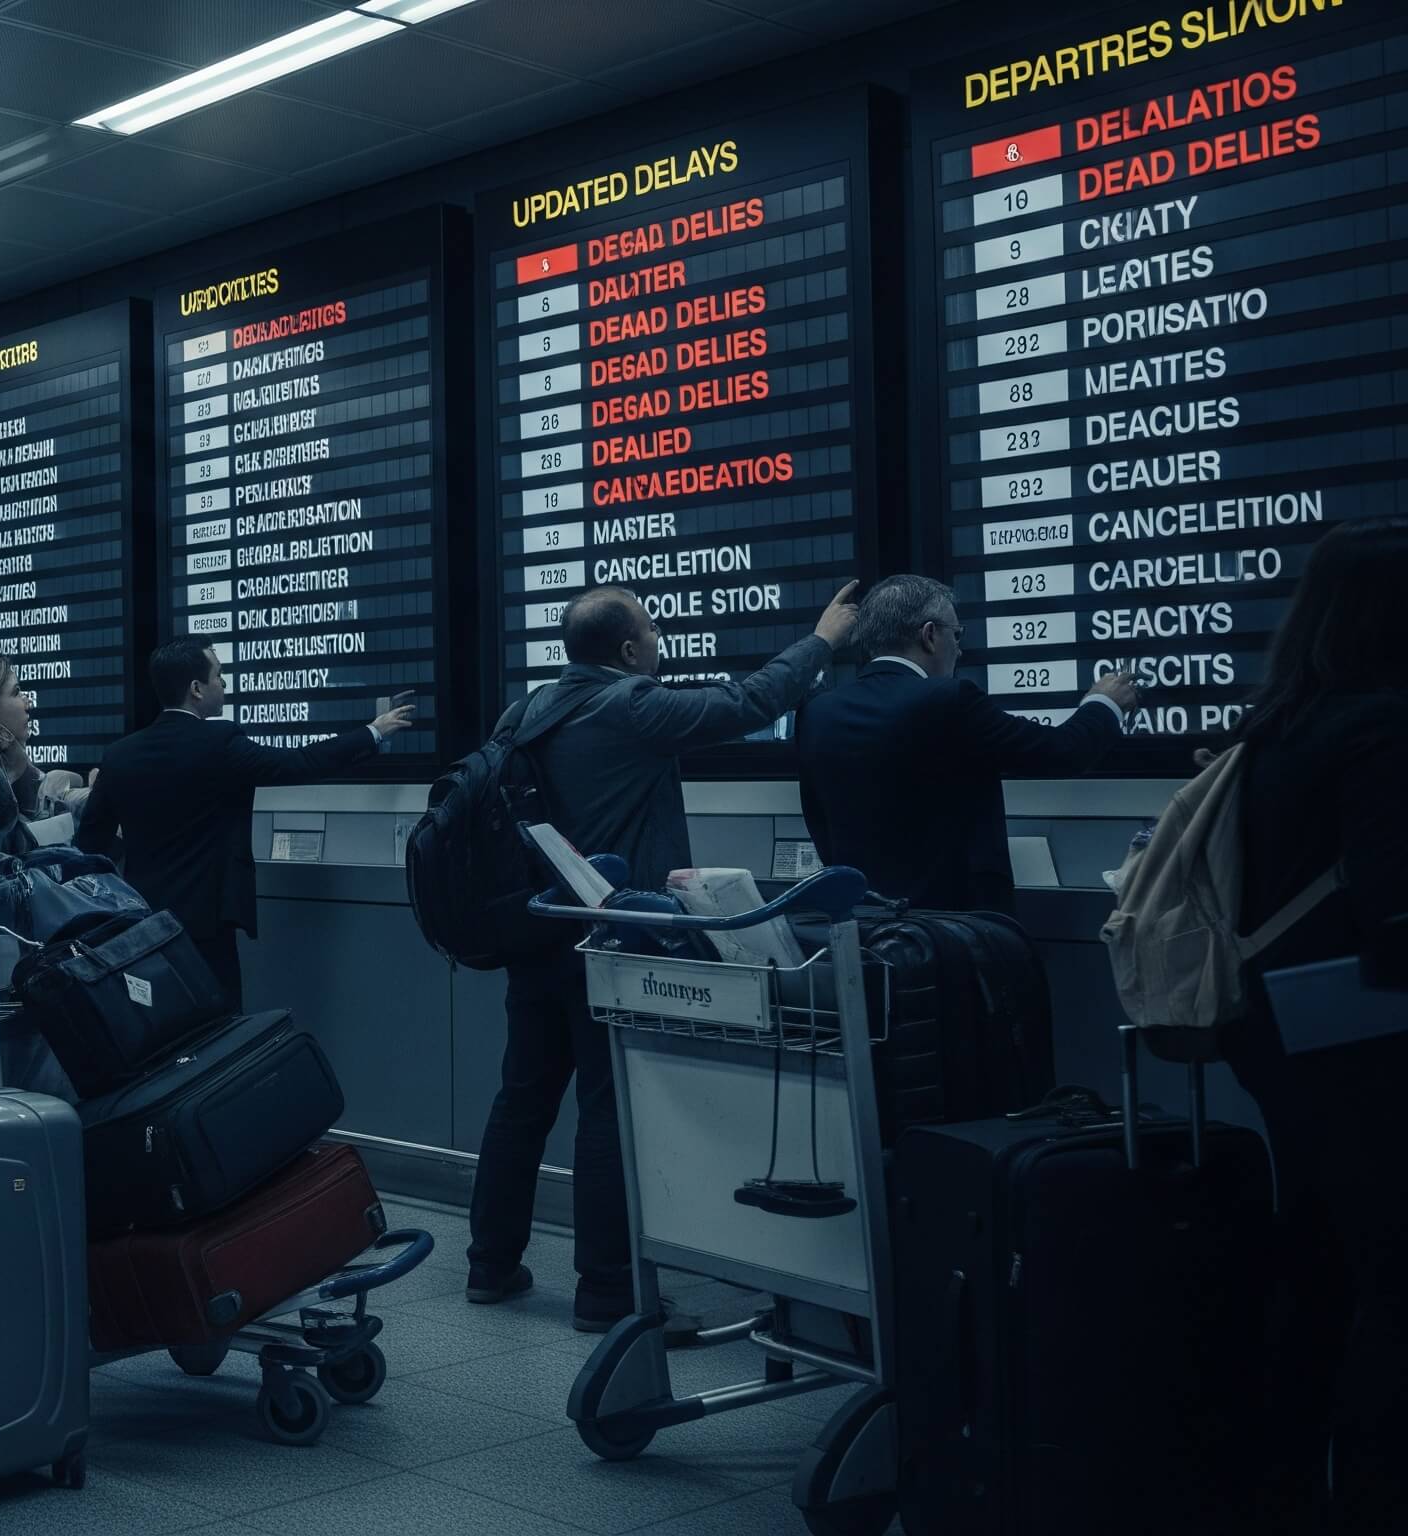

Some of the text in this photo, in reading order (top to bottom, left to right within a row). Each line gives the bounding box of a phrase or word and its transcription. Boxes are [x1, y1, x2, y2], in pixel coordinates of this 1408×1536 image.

[965, 20, 1173, 109] DEPARTRES
[1076, 66, 1297, 151] DELALATIOS
[1079, 114, 1321, 201] DEAD DELIES
[513, 140, 738, 228] UPDATED DELAYS
[672, 198, 765, 246] DELIES
[676, 285, 766, 329] DELIES
[676, 328, 768, 371] DELIES
[679, 370, 769, 412] DELIES
[592, 427, 692, 467] DEALIED
[1088, 490, 1324, 543] CANCELEITION
[637, 591, 703, 620] COLE
